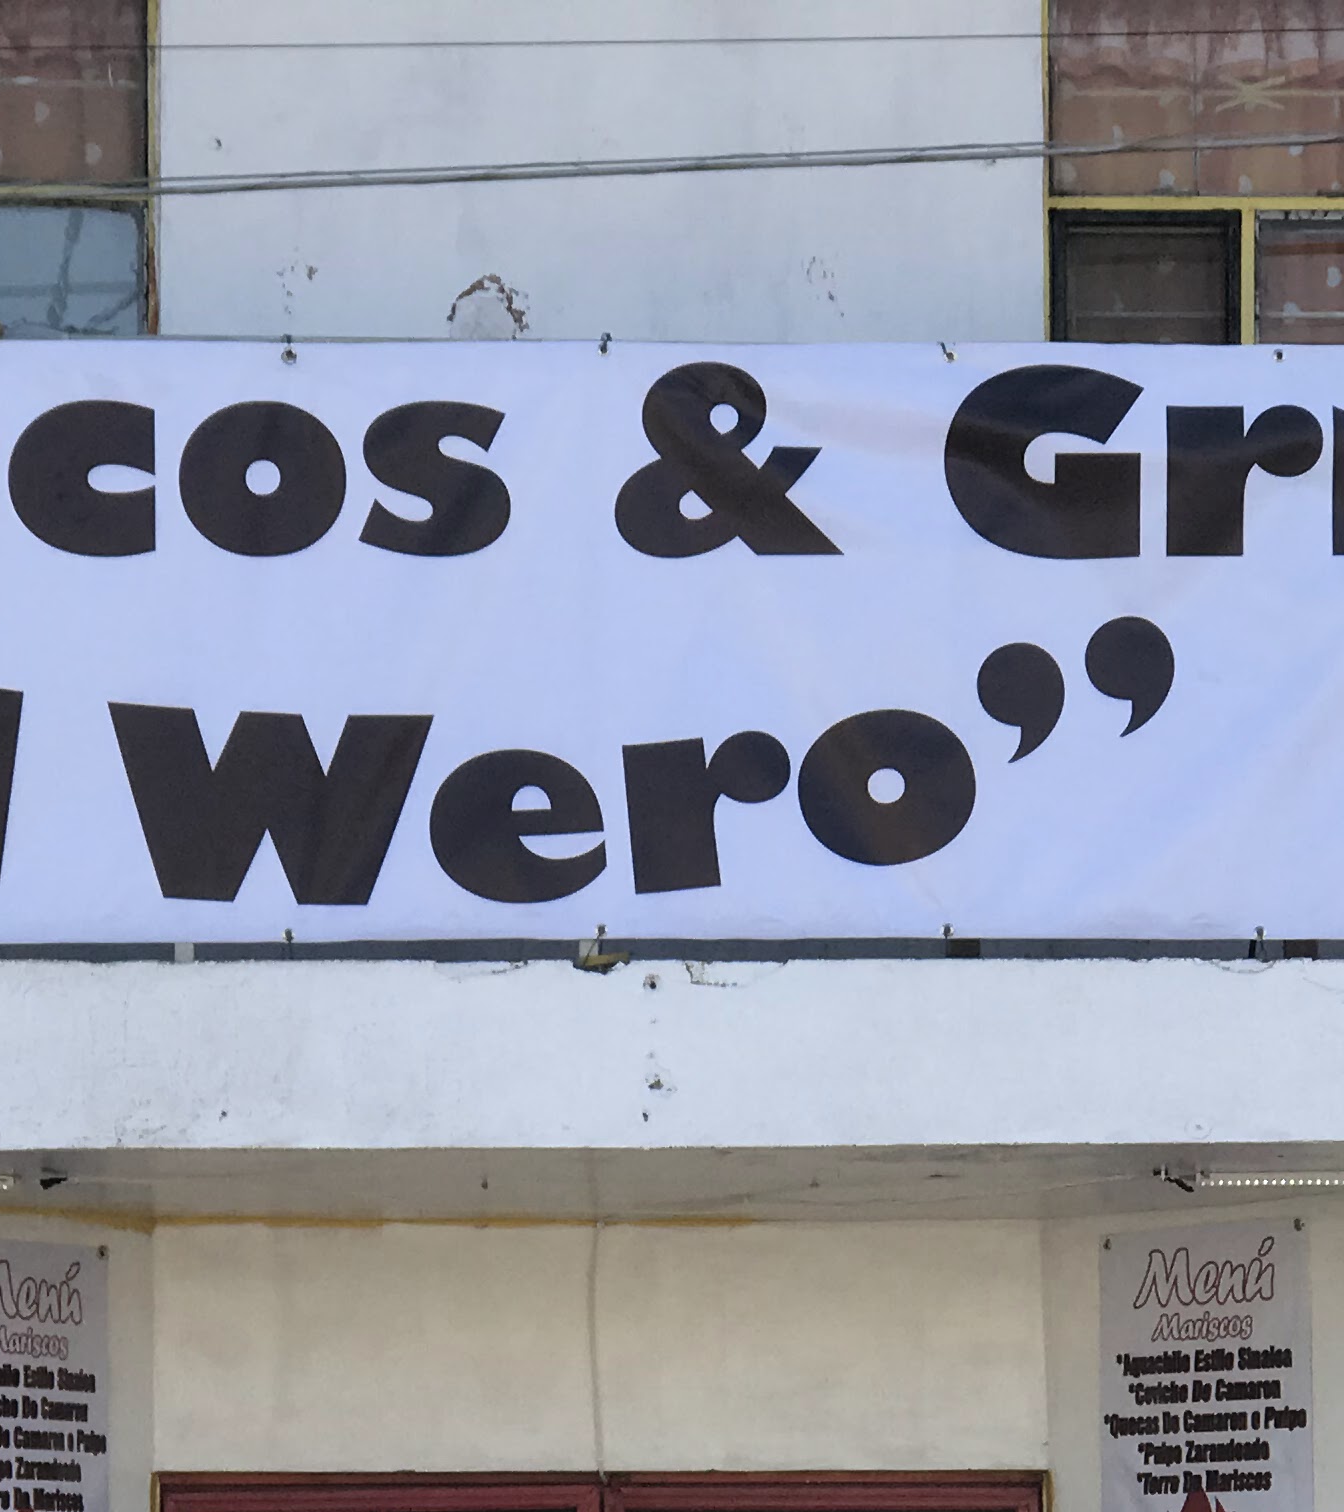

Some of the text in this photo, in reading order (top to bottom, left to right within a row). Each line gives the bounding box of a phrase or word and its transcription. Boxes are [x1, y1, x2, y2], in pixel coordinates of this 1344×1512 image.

[614, 360, 845, 559] &
[1132, 1236, 1275, 1310] Menú
[1150, 1310, 1254, 1343] Mariscos
